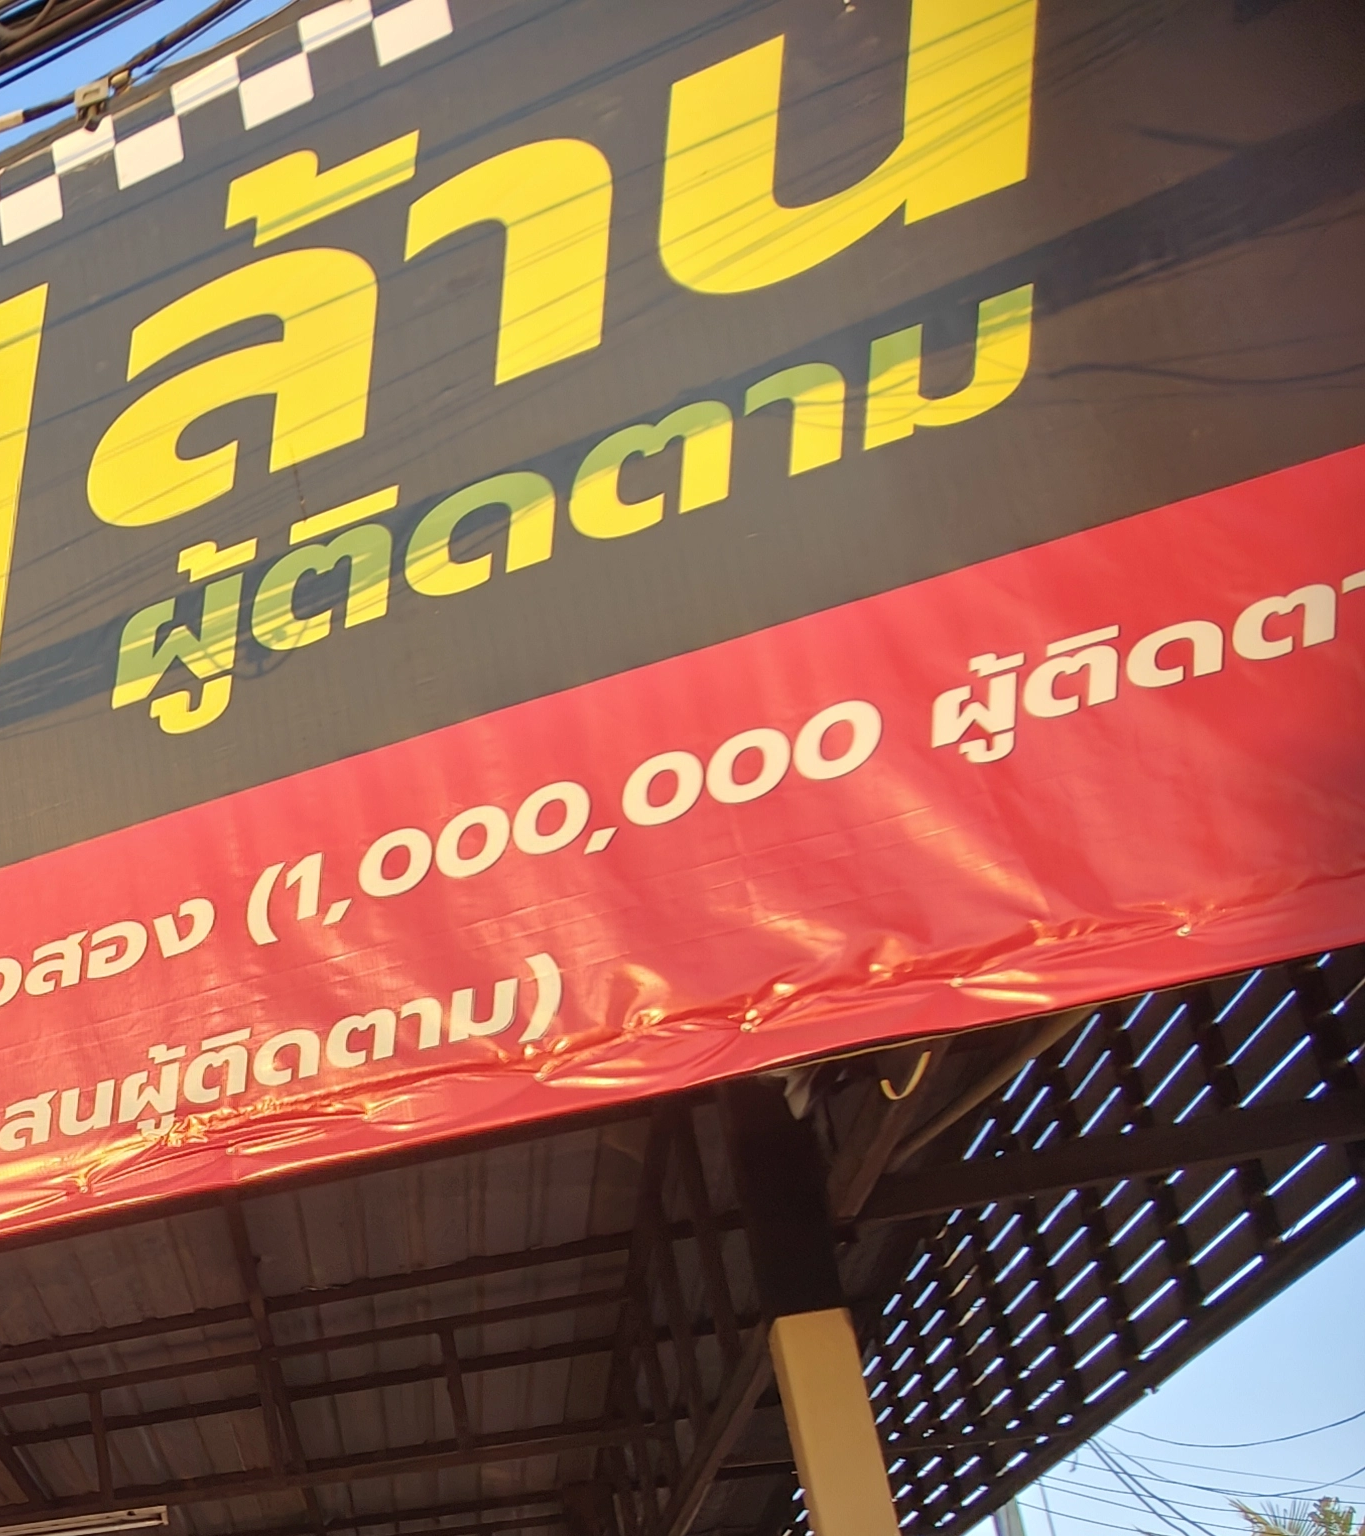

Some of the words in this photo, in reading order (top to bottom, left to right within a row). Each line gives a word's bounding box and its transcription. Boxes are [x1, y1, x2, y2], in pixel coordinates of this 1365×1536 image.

[87, 0, 1038, 528] ล้าน
[107, 283, 1035, 736] ผู้ติดตาม
[247, 701, 881, 945] (1,000,000
